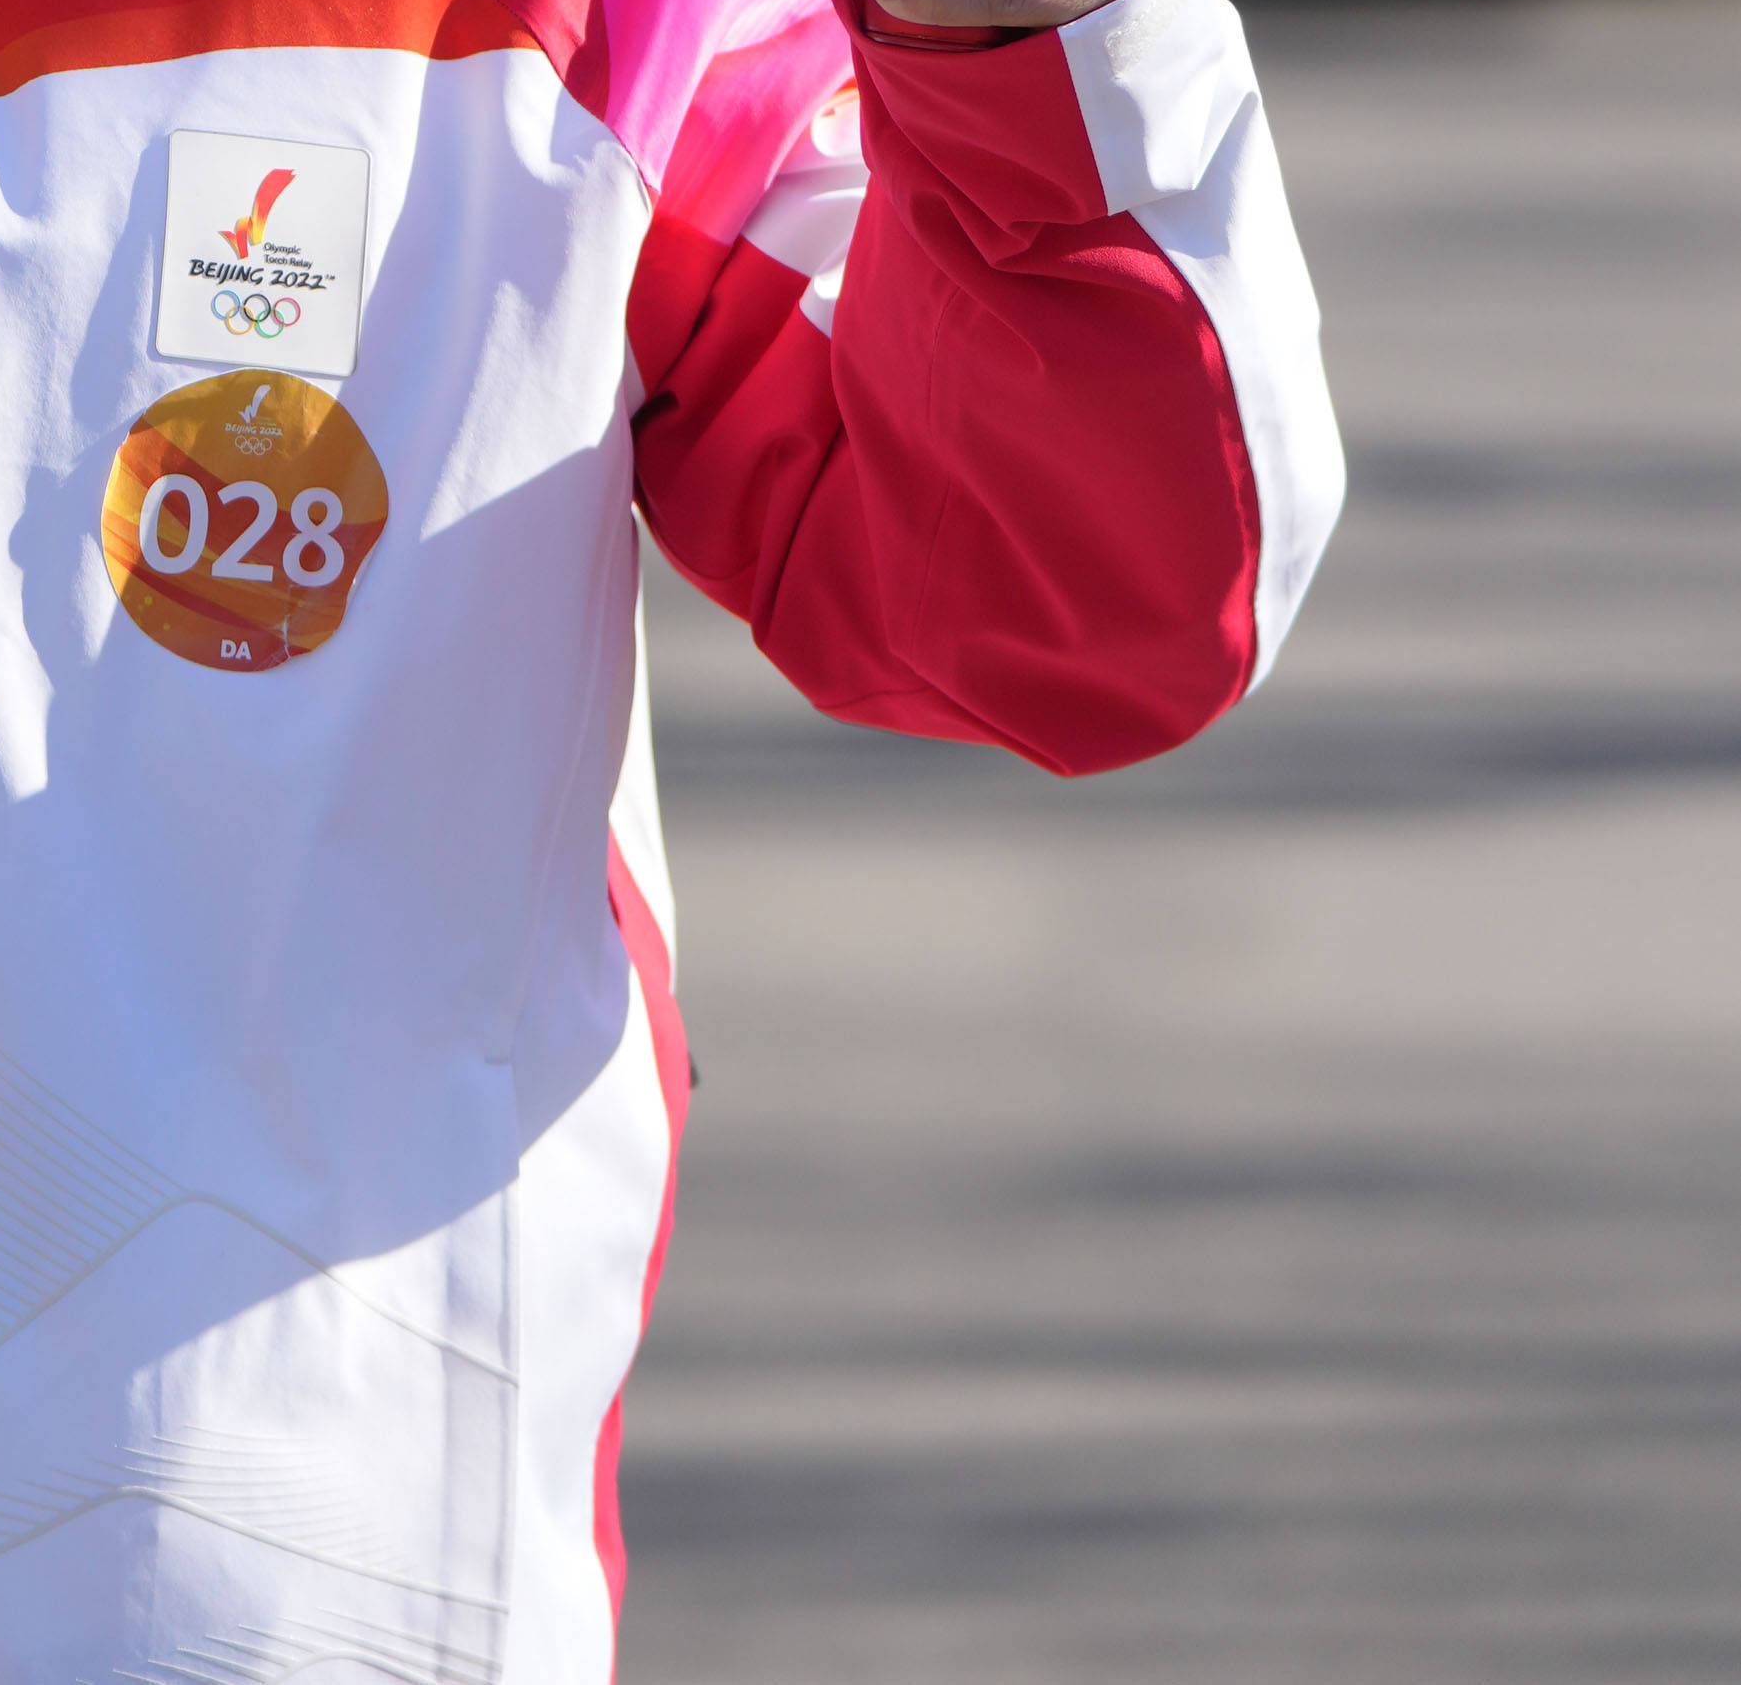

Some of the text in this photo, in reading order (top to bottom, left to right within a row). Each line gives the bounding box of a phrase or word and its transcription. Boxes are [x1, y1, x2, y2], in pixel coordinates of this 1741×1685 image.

[263, 241, 301, 255] Olympic
[264, 254, 313, 269] Torch Relay
[188, 258, 264, 285] BEIJING
[225, 422, 257, 435] BEIJING
[139, 473, 345, 588] 028
[220, 639, 252, 660] DA
